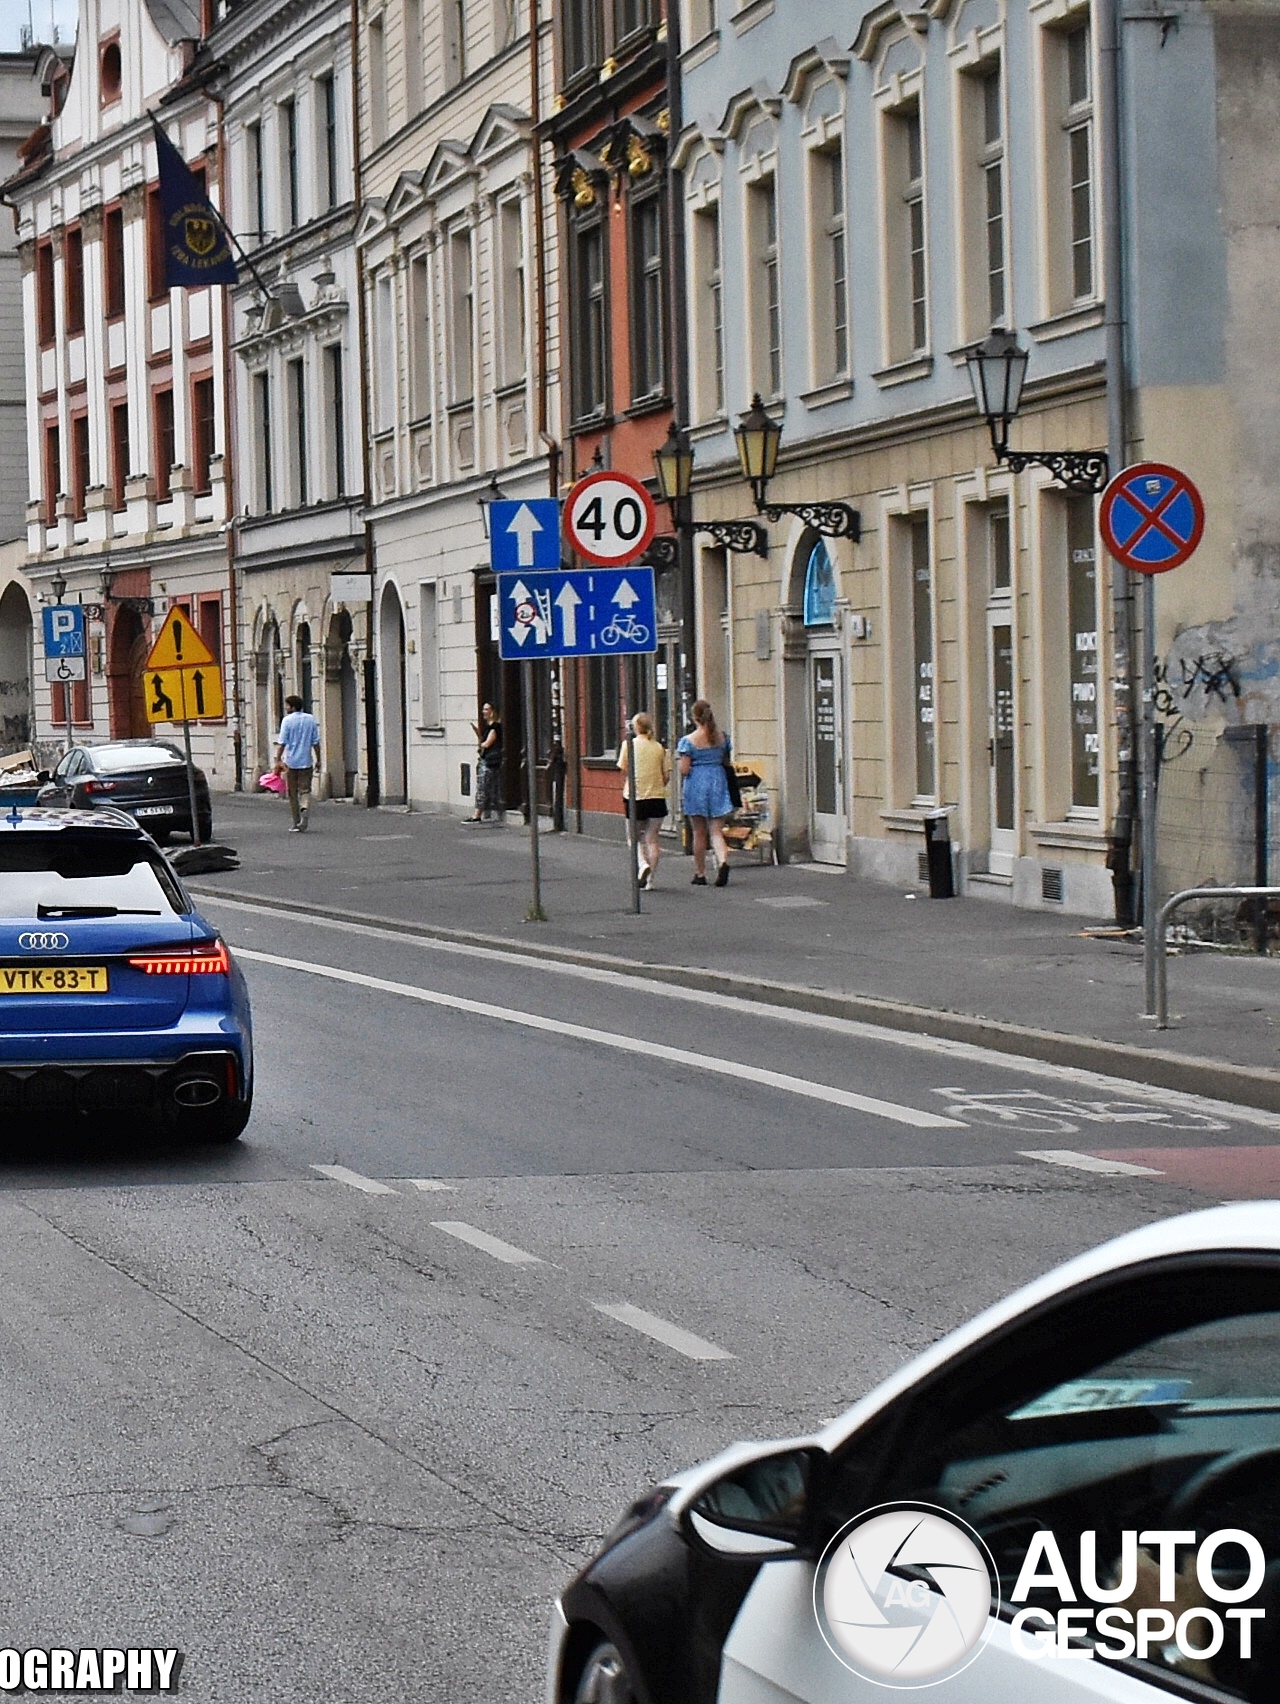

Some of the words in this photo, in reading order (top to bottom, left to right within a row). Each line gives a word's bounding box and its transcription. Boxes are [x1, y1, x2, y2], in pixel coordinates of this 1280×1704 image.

[577, 497, 641, 541] 40
[52, 610, 75, 642] P
[3, 970, 99, 989] VTK-83-T
